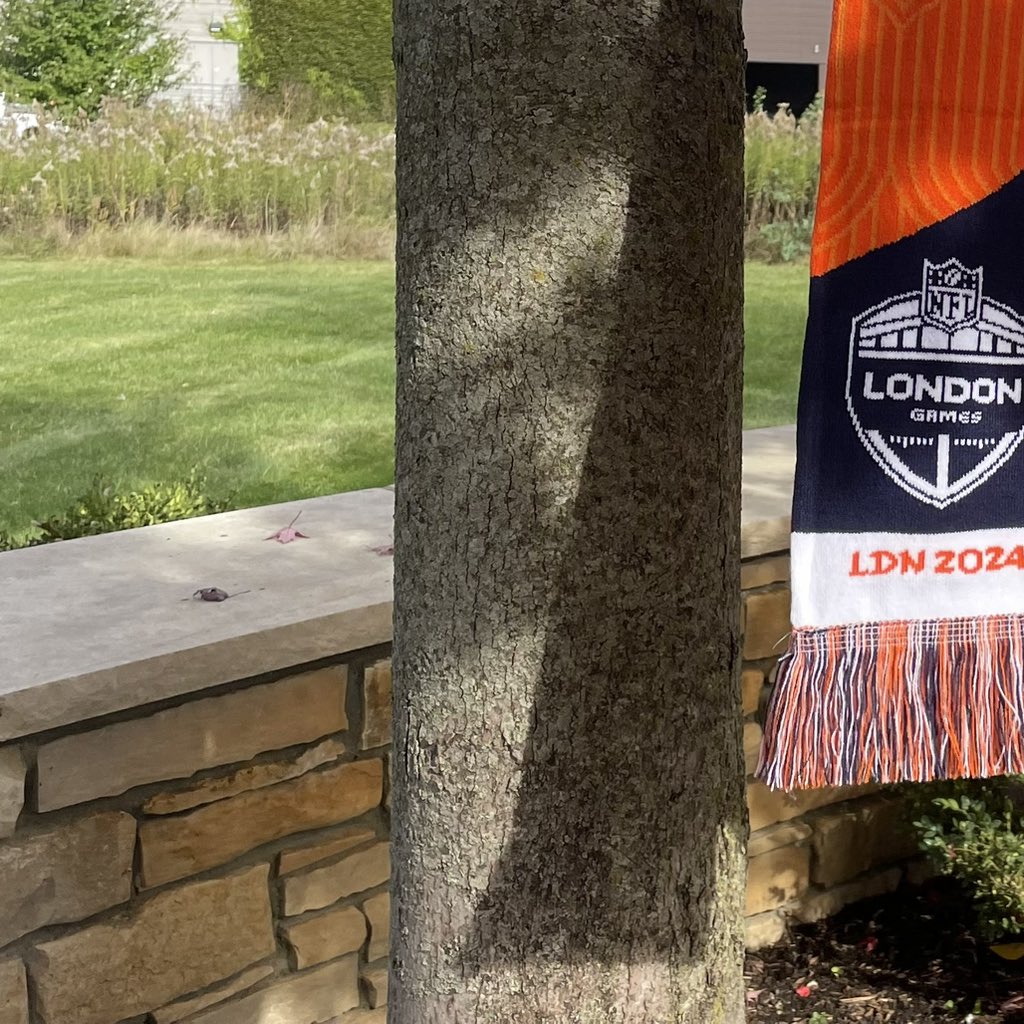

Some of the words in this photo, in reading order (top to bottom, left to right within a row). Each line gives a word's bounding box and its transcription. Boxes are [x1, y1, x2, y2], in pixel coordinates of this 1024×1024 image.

[863, 372, 1022, 404] LONDON
[910, 408, 982, 424] GAMES
[849, 549, 925, 576] LDN
